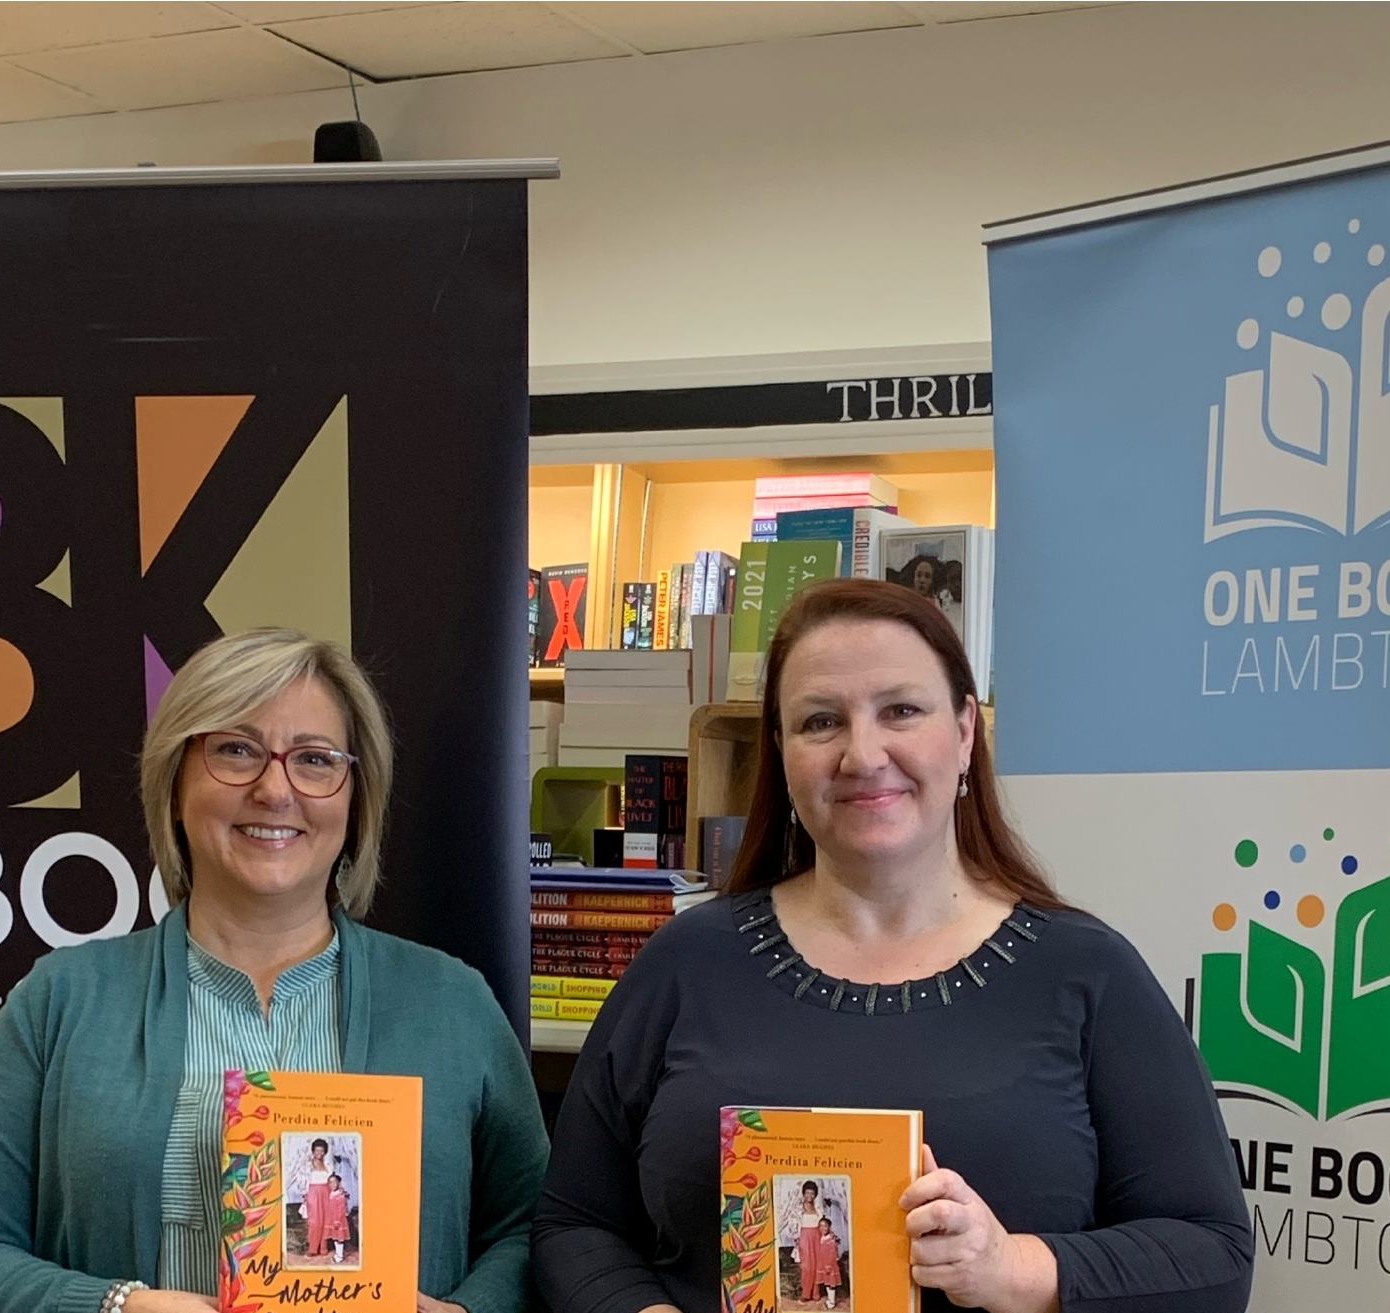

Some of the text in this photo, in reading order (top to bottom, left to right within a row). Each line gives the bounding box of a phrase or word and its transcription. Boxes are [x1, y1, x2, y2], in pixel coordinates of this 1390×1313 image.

[826, 374, 992, 422] THRIL
[741, 560, 767, 611] 2021
[1203, 564, 1320, 626] ONE
[656, 572, 668, 647] PETER JAMES
[530, 893, 568, 905] LITION
[583, 895, 650, 908] KAEPERNICK
[529, 913, 568, 925] LITION
[583, 915, 650, 928] KAEPERNICK
[577, 950, 601, 959] CYCLE
[579, 966, 603, 975] CYCLE
[566, 984, 607, 994] SHOPPING
[273, 1112, 374, 1127] Perdita Felicien
[764, 1154, 863, 1169] Perdita Felicien
[244, 1255, 282, 1286] My
[275, 1276, 383, 1307] Mother's
